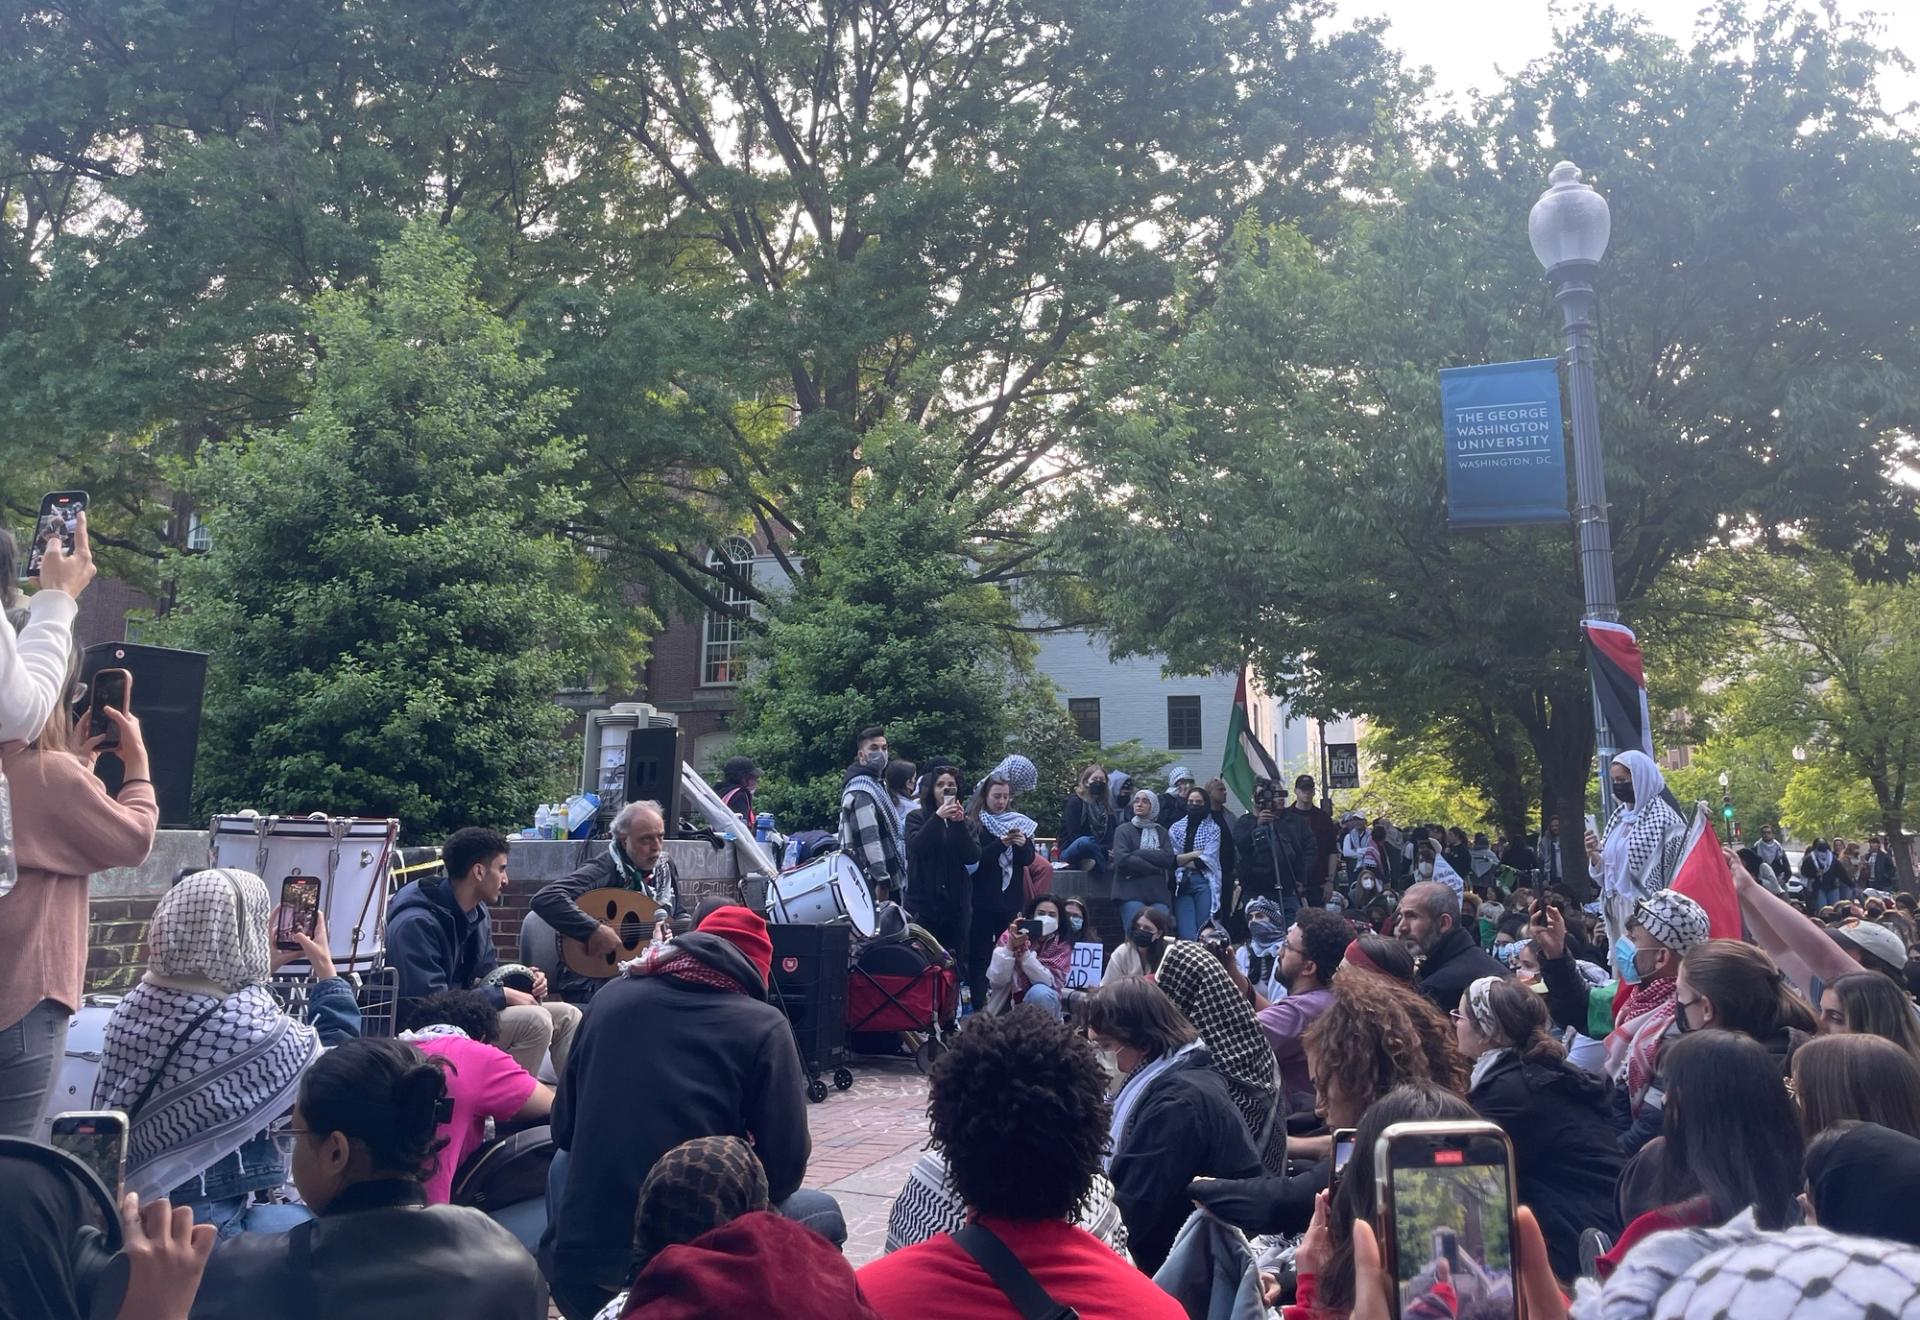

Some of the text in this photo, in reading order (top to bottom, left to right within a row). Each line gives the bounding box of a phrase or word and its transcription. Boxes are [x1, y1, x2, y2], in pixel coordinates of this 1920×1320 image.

[1457, 408, 1548, 423] THE GEORGE
[1457, 421, 1549, 437] WASHINGTON
[1457, 435, 1549, 450] UNIVERSITY
[1458, 456, 1552, 469] WASHINGTON, DC
[1331, 758, 1356, 774] REVS
[1070, 947, 1102, 969] IDE
[1066, 970, 1088, 988] AD
